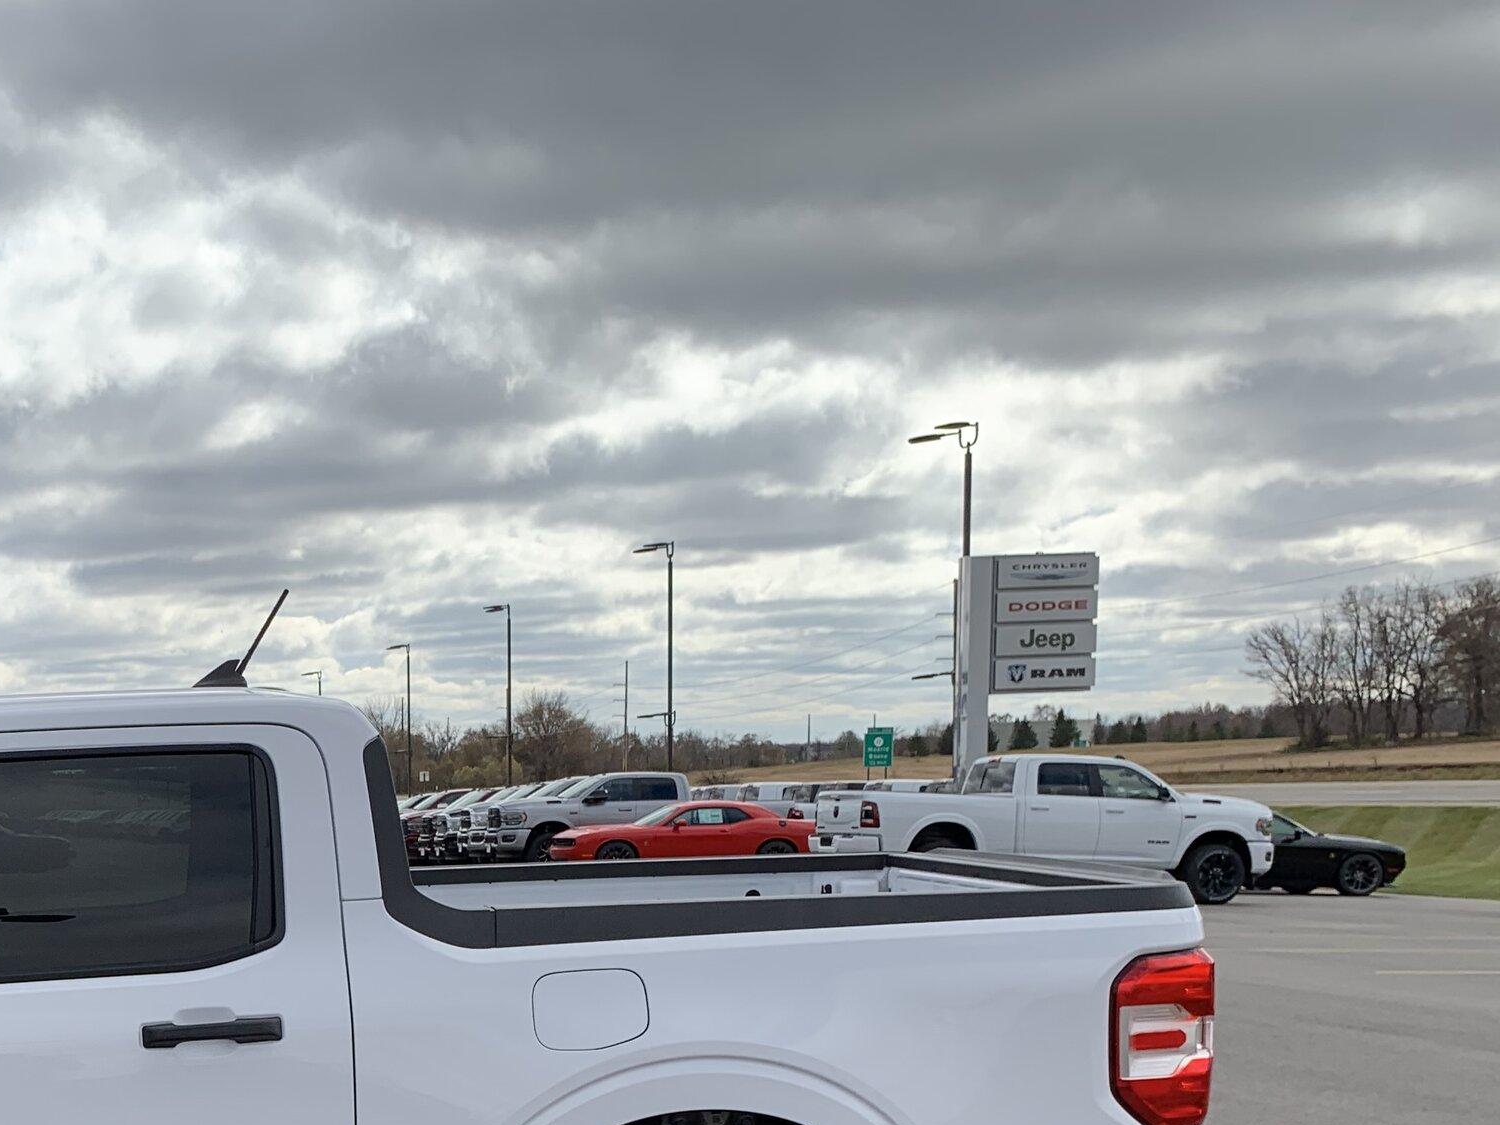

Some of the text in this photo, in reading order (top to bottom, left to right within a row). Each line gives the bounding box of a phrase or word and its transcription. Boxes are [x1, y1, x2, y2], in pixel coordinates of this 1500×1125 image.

[1012, 562, 1087, 571] CHRYSLER
[1008, 600, 1088, 612] DODGE
[1020, 629, 1076, 651] Jeep
[1030, 667, 1086, 679] RAM
